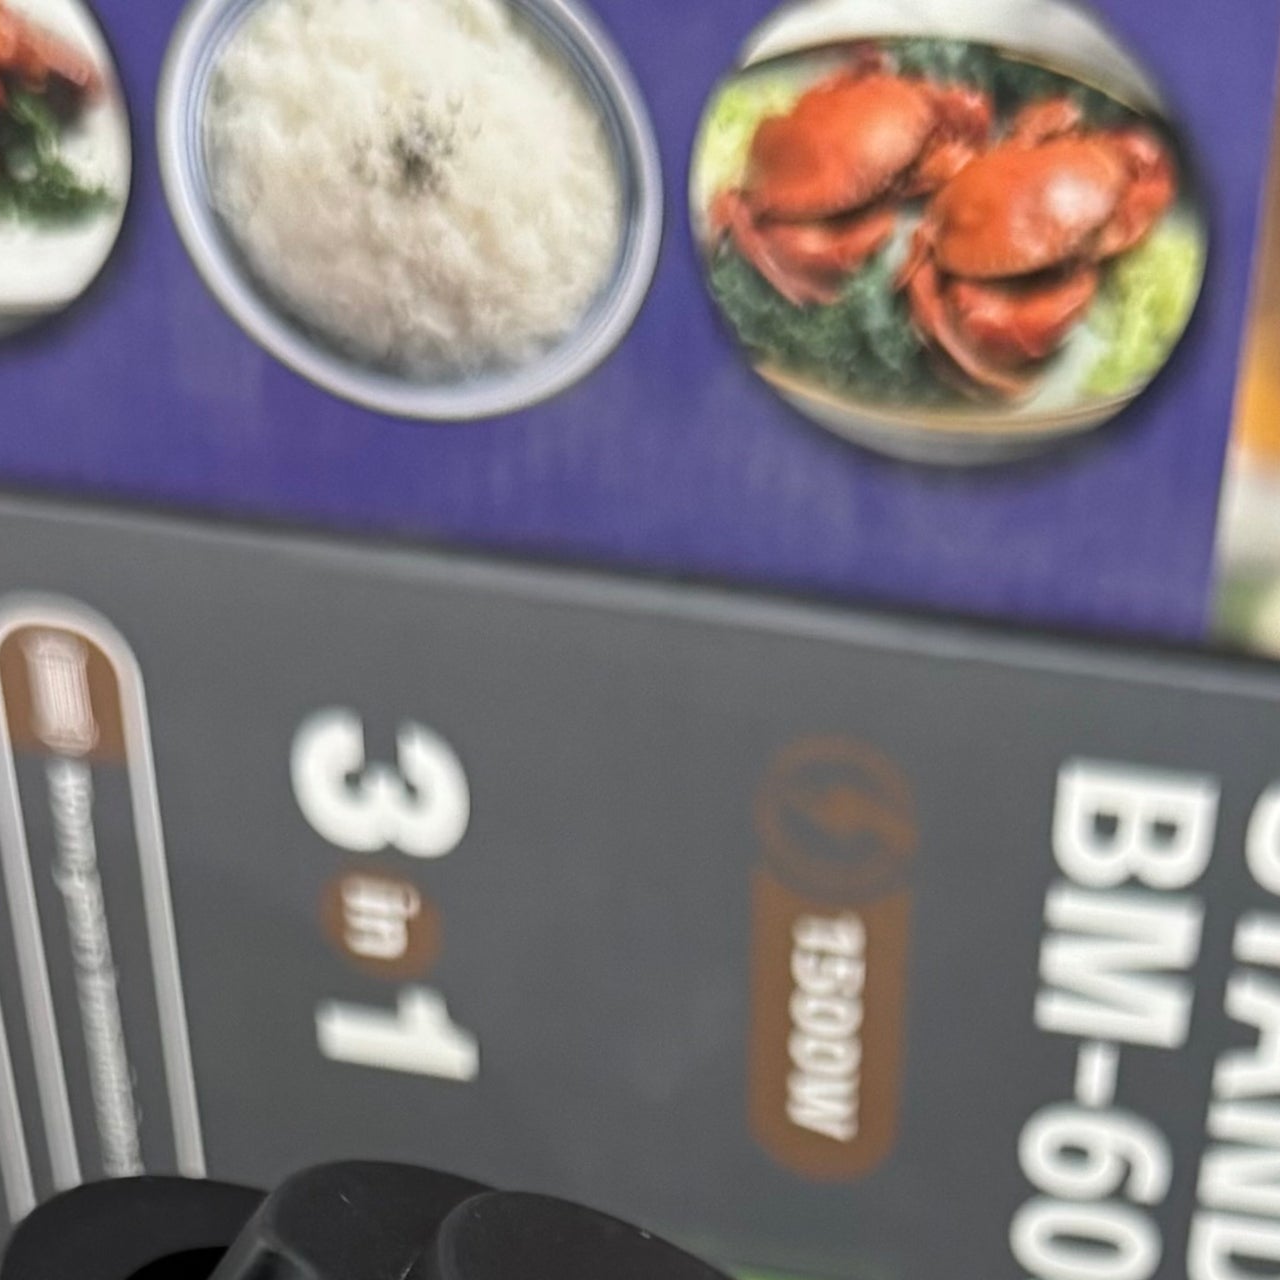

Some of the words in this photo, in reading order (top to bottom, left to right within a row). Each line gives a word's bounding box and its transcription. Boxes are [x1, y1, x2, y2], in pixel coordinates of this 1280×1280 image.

[289, 706, 472, 860] 3
[342, 873, 422, 960] in
[314, 983, 481, 1083] 1
[785, 911, 867, 1142] 1500W
